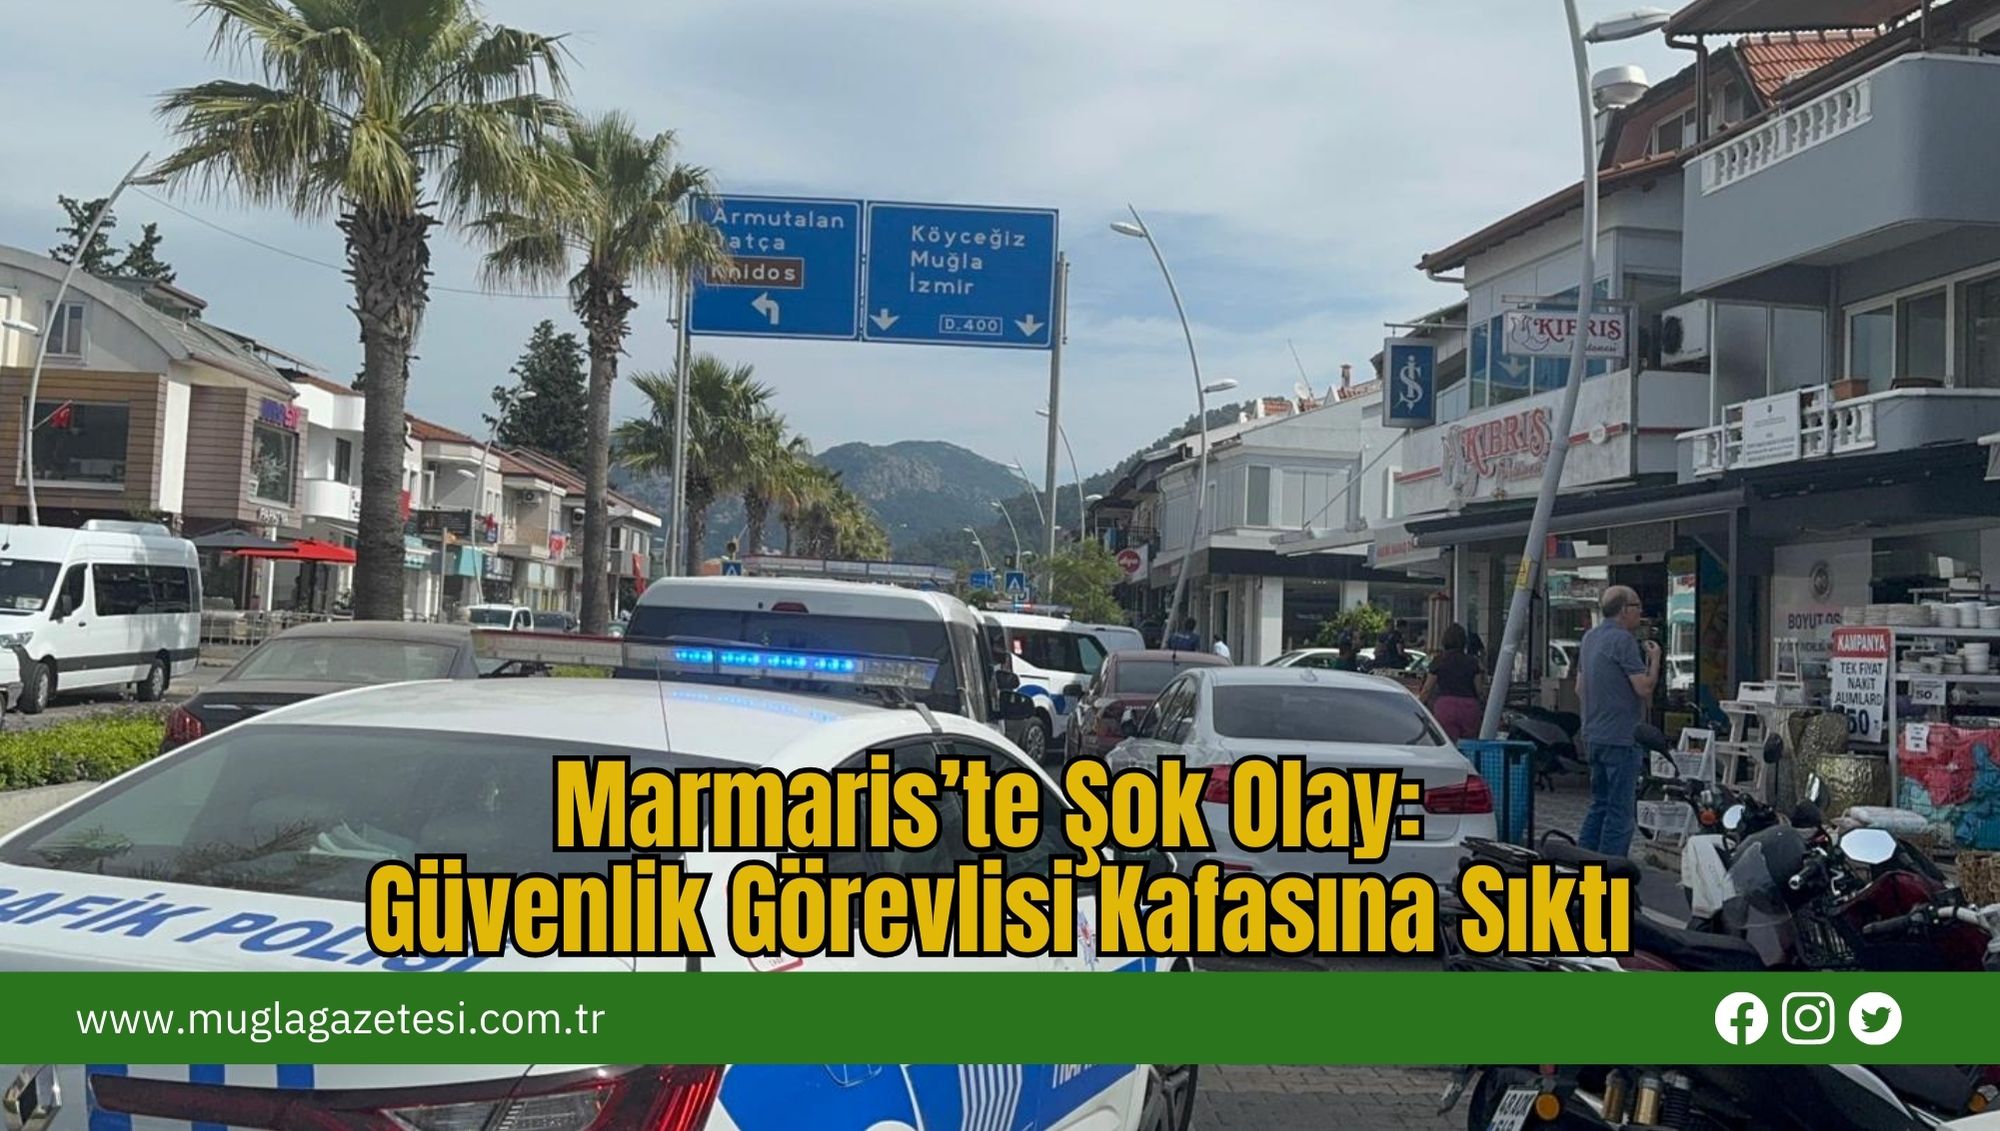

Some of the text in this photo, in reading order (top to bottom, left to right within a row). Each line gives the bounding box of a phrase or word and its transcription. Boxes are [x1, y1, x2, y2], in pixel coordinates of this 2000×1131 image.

[710, 206, 845, 229] Armutalan
[911, 225, 1026, 250] Köyceğiz
[910, 250, 984, 273] Muğla
[909, 270, 975, 295] İzmir
[944, 317, 999, 332] D.400
[1461, 408, 1546, 478] KIBRIS
[1837, 633, 1887, 652] KAMPANYA
[1840, 662, 1857, 675] TEK
